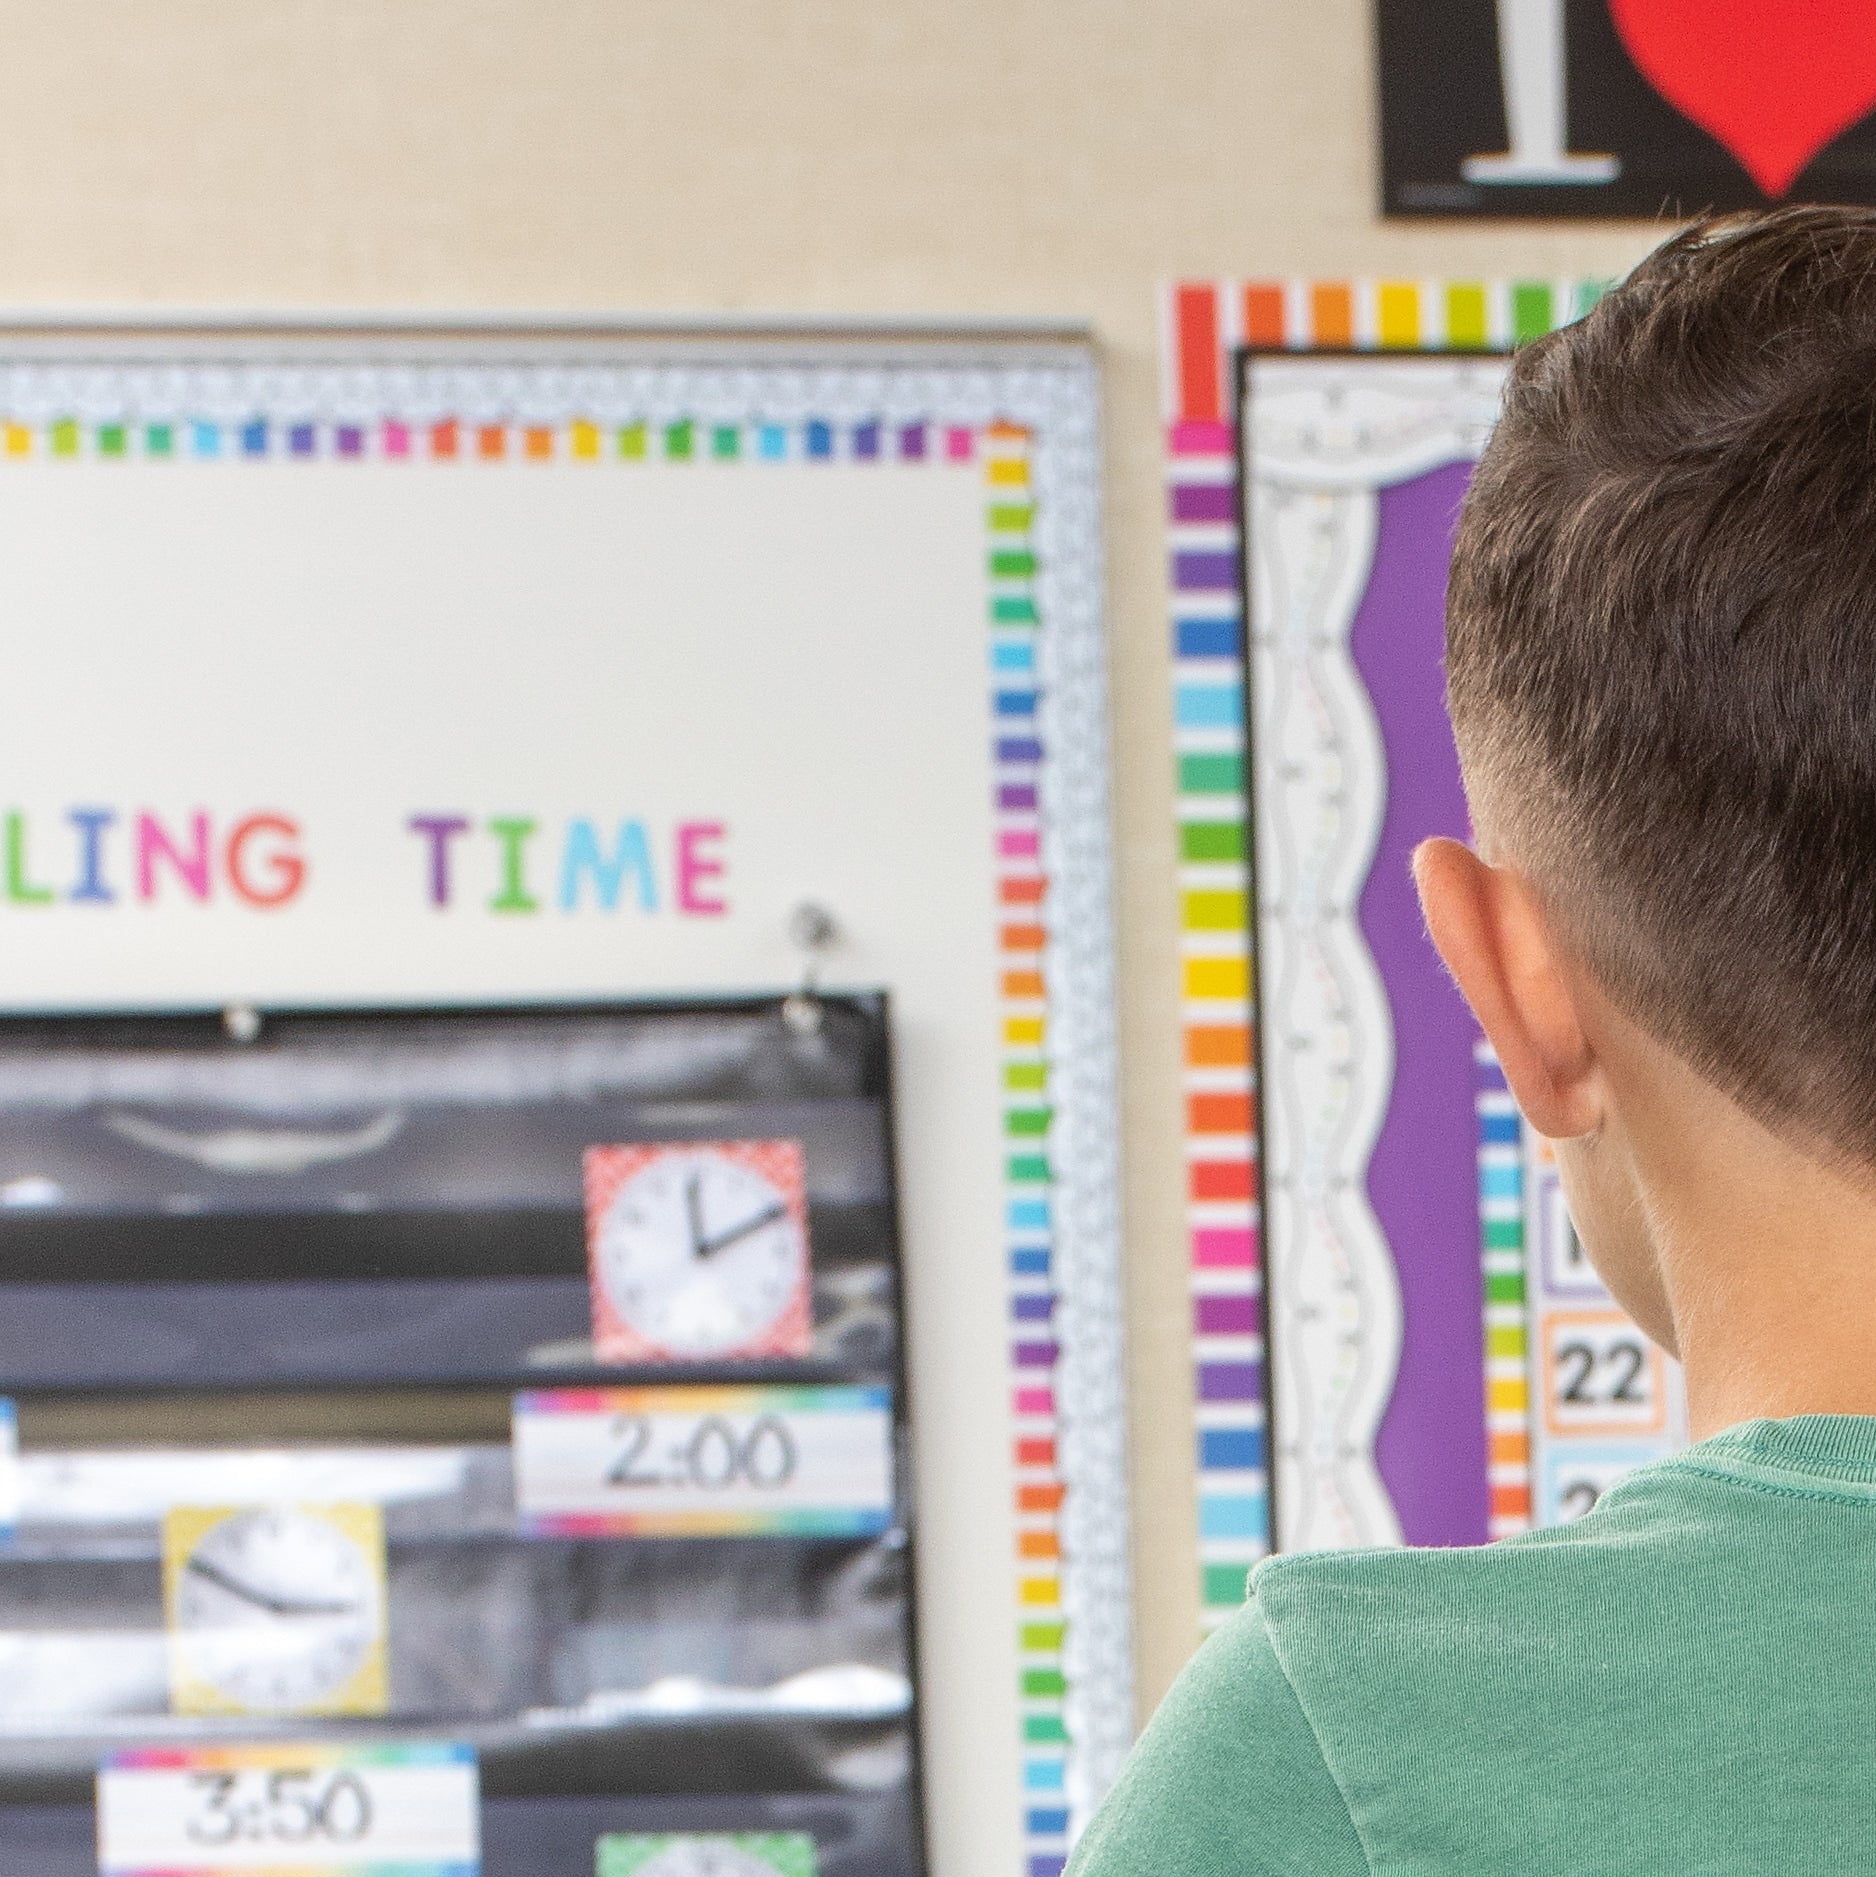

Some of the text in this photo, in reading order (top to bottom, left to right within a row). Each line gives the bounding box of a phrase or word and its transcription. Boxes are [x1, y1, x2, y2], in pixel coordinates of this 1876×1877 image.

[3, 808, 730, 918] LING TIME
[1557, 1341, 1648, 1403] 22
[608, 1413, 797, 1490] 2:00
[187, 1768, 372, 1843] 3:50
